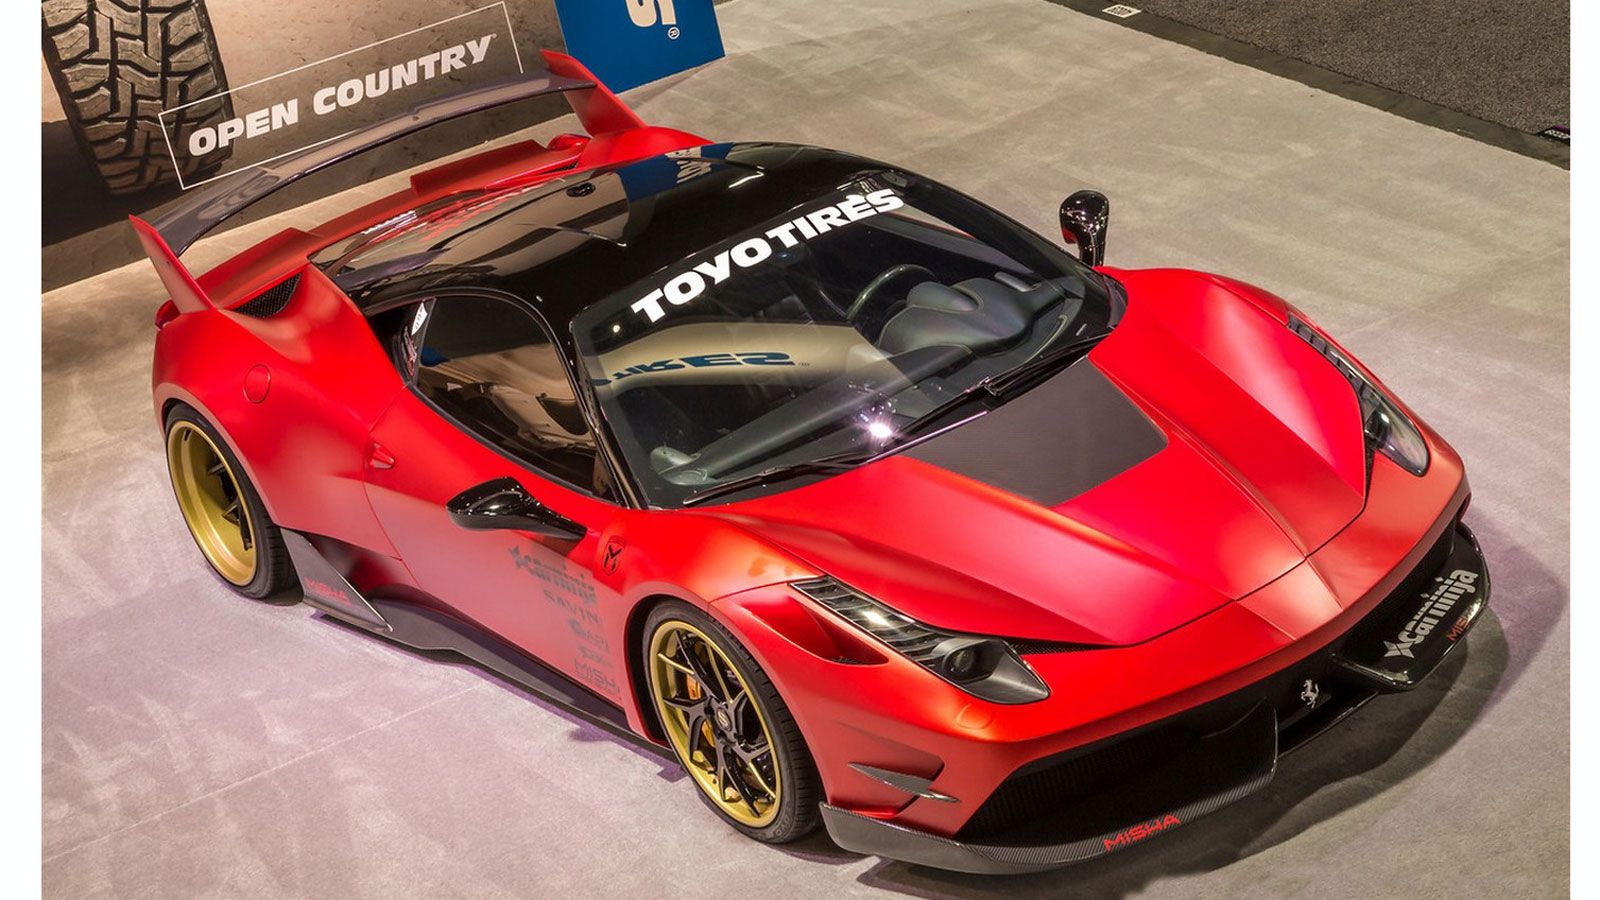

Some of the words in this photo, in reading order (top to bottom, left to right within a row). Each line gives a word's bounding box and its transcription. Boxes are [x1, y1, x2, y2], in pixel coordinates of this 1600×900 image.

[189, 99, 298, 156] OPEN
[313, 34, 493, 116] COUNTRY
[1398, 569, 1479, 645] carninja
[1103, 813, 1181, 853] MISHA
